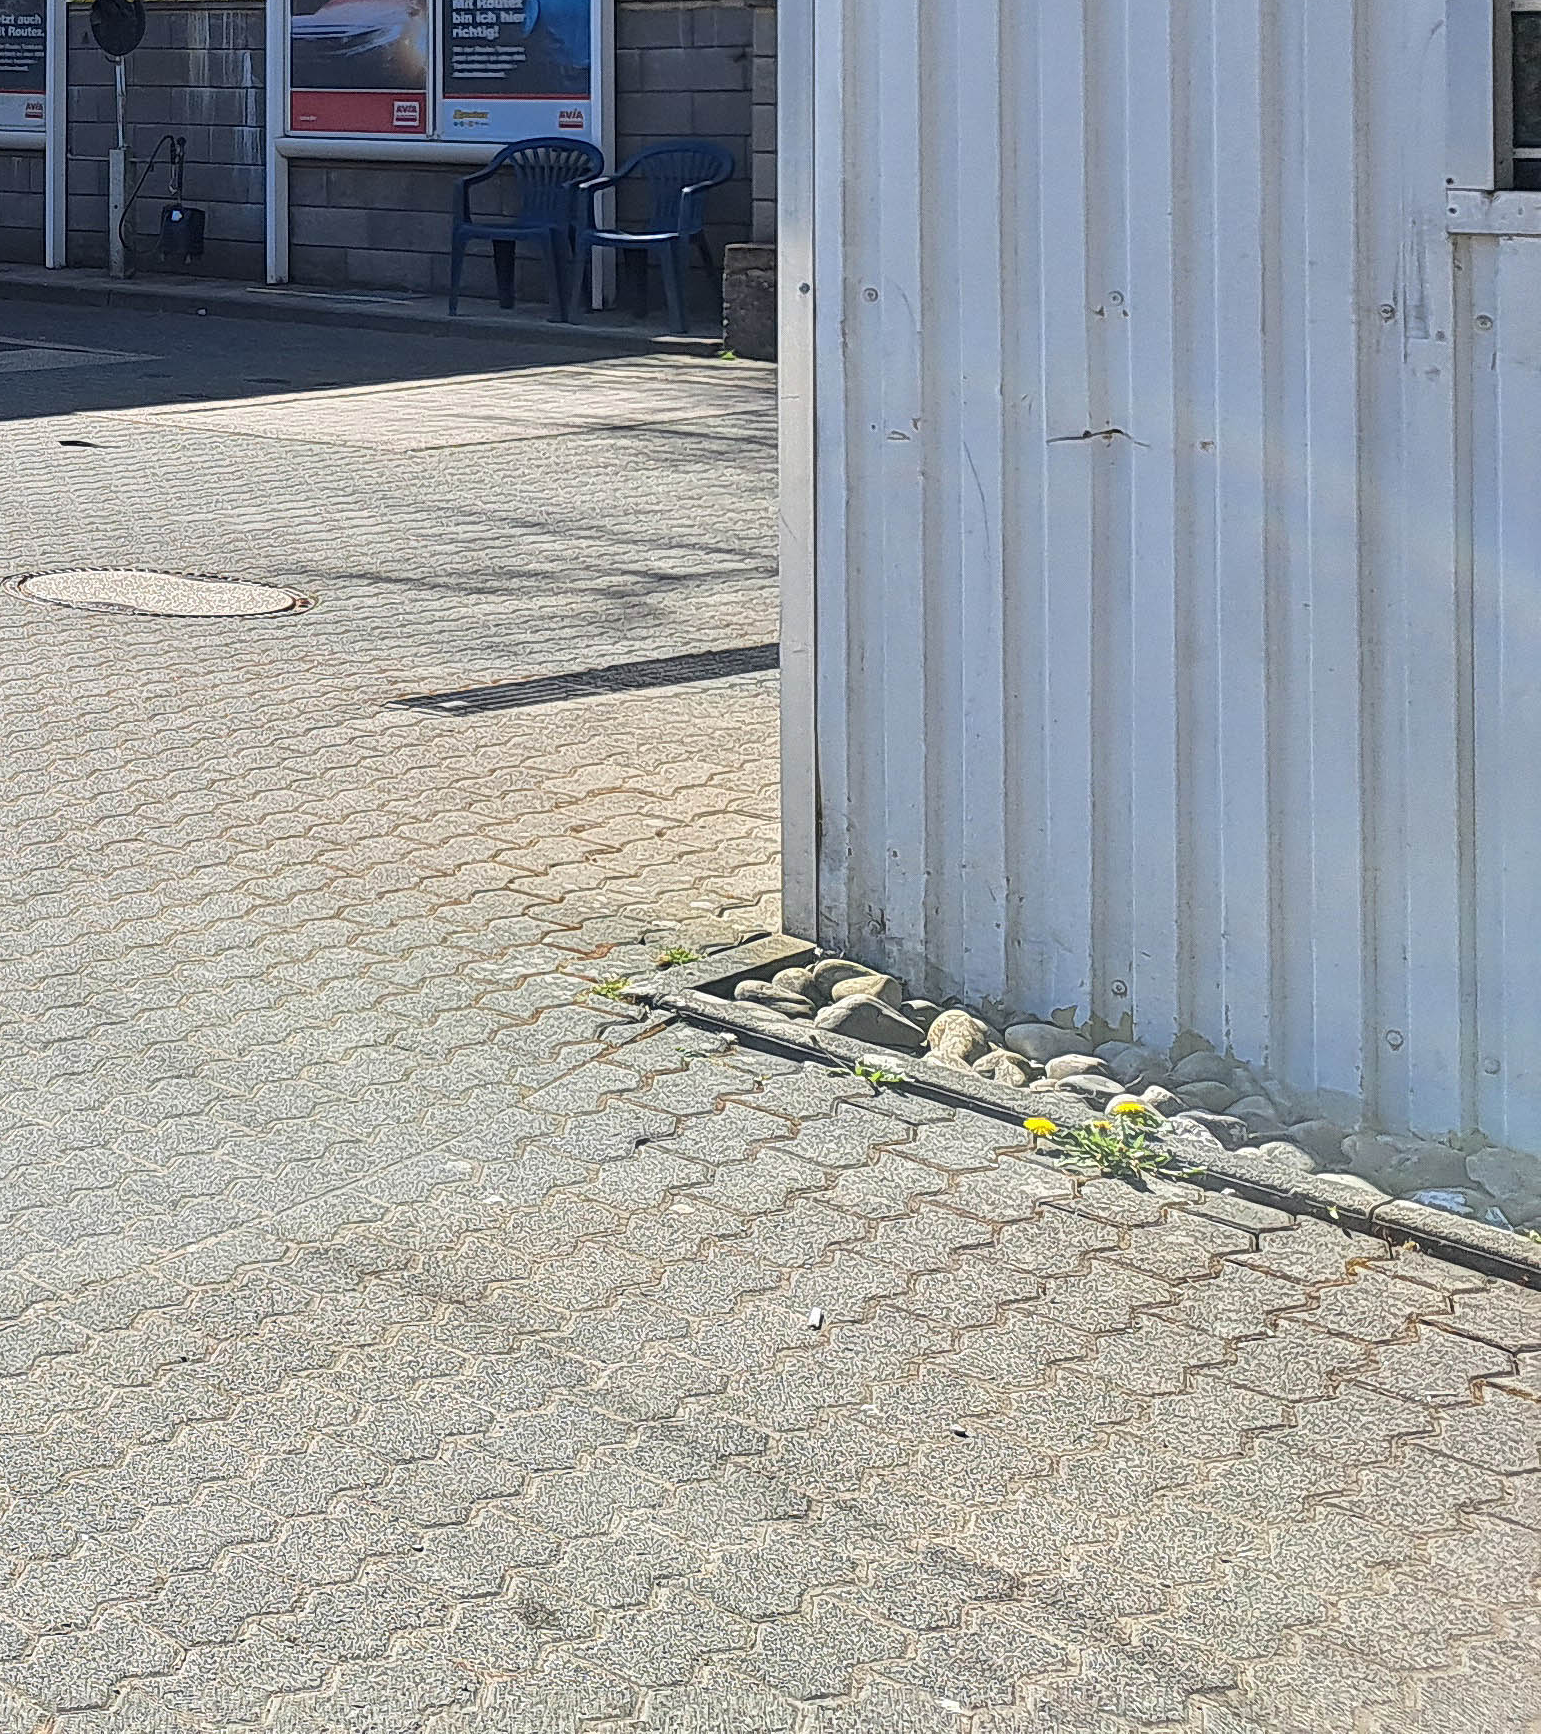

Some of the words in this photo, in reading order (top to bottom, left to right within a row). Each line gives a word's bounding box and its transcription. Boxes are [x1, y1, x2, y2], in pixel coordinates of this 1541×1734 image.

[17, 13, 42, 24] auch
[452, 11, 473, 24] bin
[476, 11, 497, 24] ich
[500, 11, 526, 23] hier
[452, 26, 500, 41] richtig!
